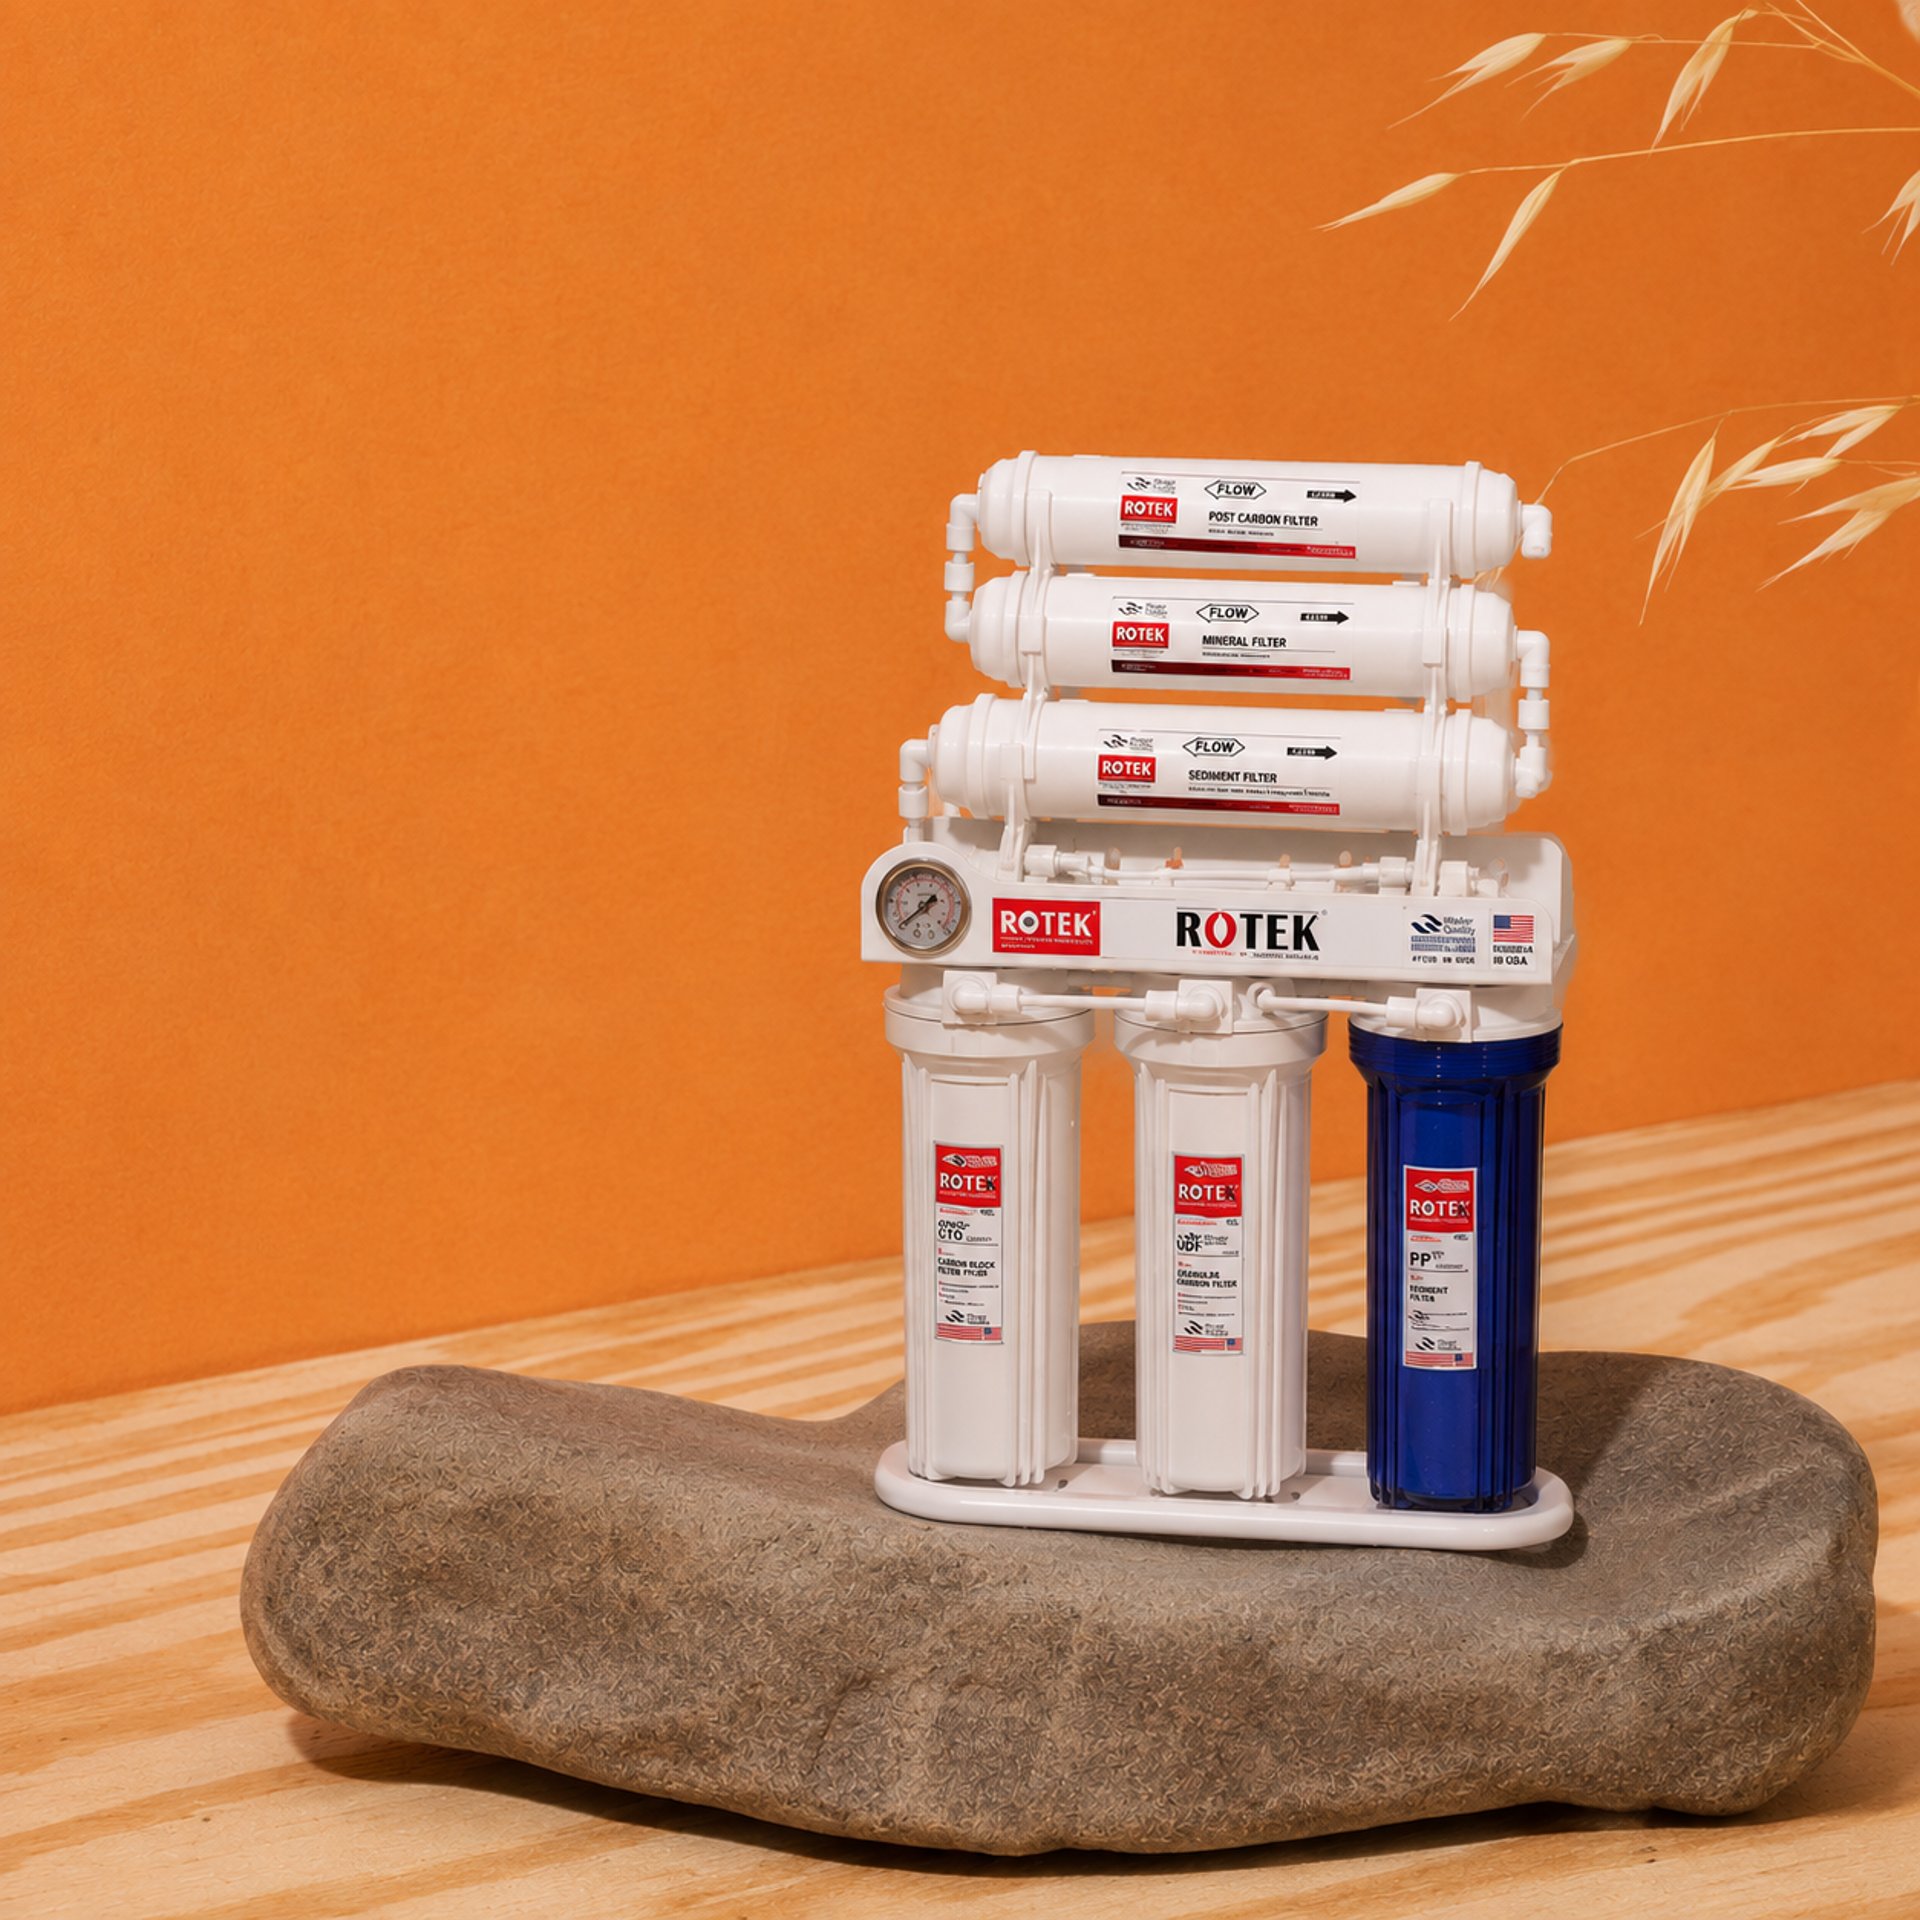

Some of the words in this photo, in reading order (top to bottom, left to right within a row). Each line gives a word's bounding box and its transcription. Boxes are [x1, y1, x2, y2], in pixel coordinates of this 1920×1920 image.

[1216, 483, 1256, 496] FLOW
[1124, 501, 1173, 517] ROTEK
[1208, 511, 1235, 523] POST
[1237, 512, 1281, 525] CARBON
[1282, 515, 1319, 527] FILTER
[1208, 607, 1249, 619] FLOW
[1116, 626, 1165, 642] ROTEK
[1202, 635, 1248, 648] MINERAL
[1251, 636, 1287, 648] FILTER
[1195, 741, 1235, 753] FLOW
[1102, 760, 1152, 776] ROTEK
[1188, 770, 1241, 783] SEDIMENT
[1243, 772, 1277, 783] FILTER
[1000, 910, 1093, 937] ROTEK
[1176, 910, 1320, 951] ROTEK
[940, 1172, 997, 1191] ROTEK
[1178, 1183, 1239, 1201] ROTEK
[1409, 1199, 1470, 1217] ROTEK
